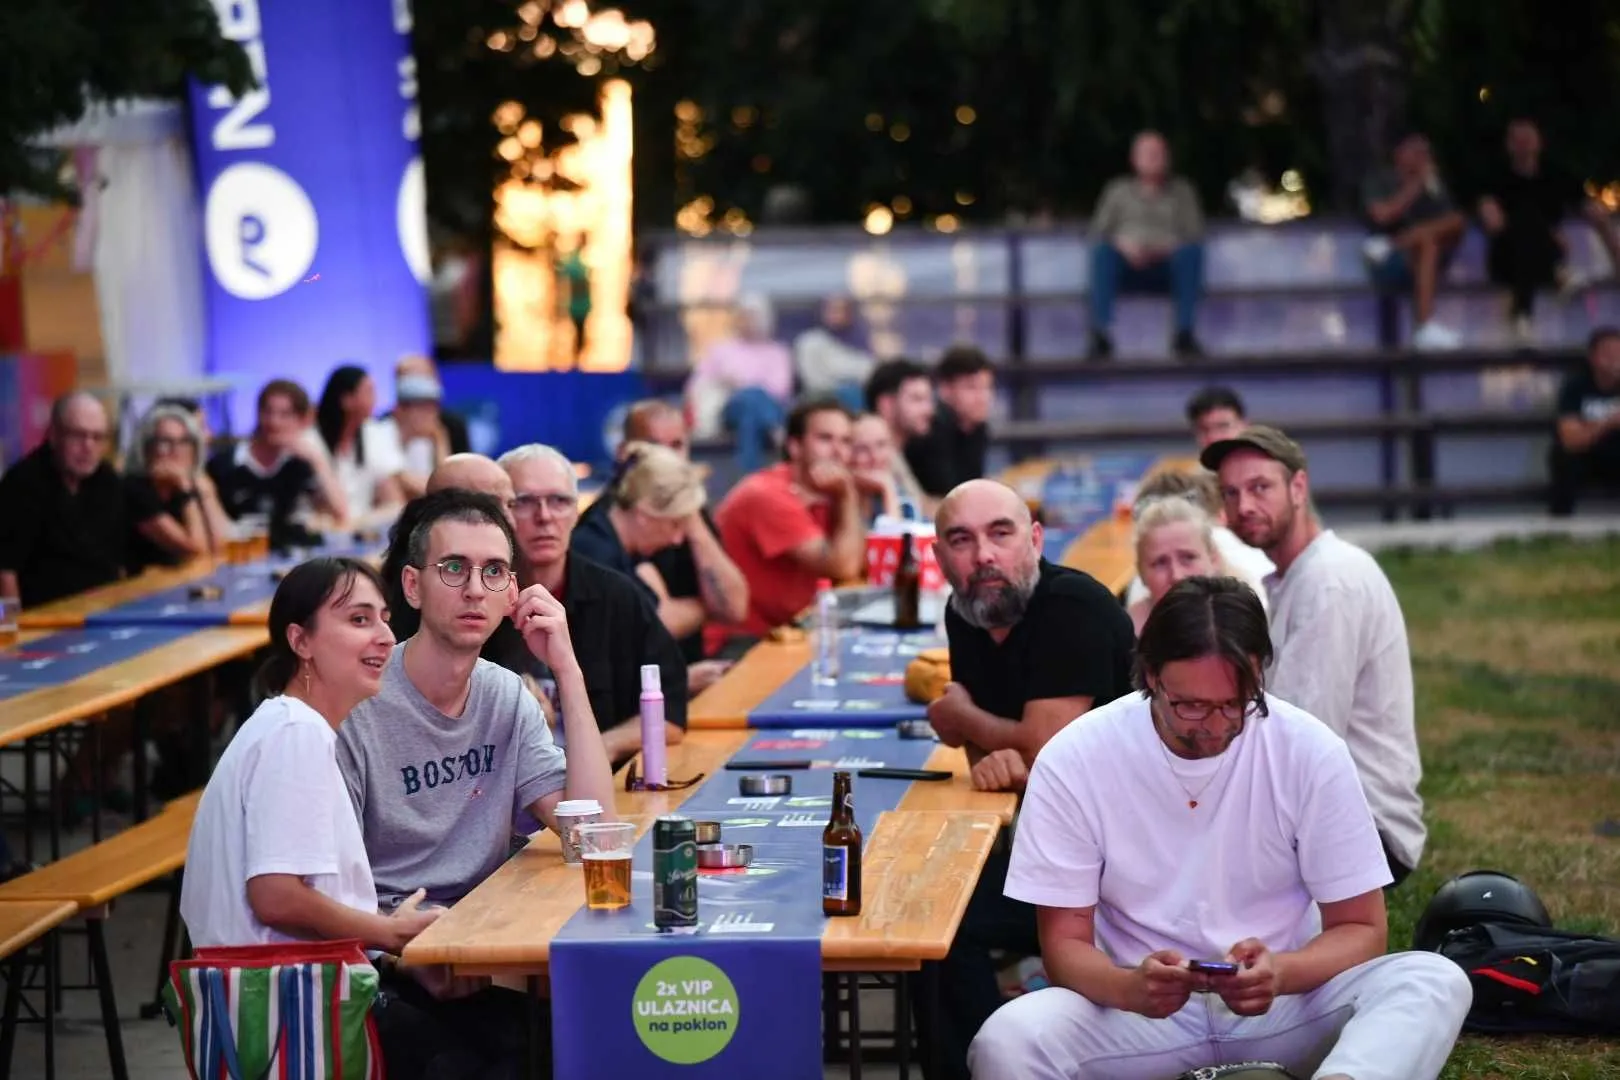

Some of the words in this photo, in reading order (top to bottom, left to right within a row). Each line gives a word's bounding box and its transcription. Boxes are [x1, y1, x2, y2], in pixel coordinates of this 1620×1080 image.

[400, 744, 497, 795] BOSTON
[656, 980, 677, 996] 2x
[681, 980, 713, 995] VIP
[637, 999, 733, 1016] ULAZNICA
[649, 1021, 669, 1033] na
[673, 1018, 727, 1034] poklon
